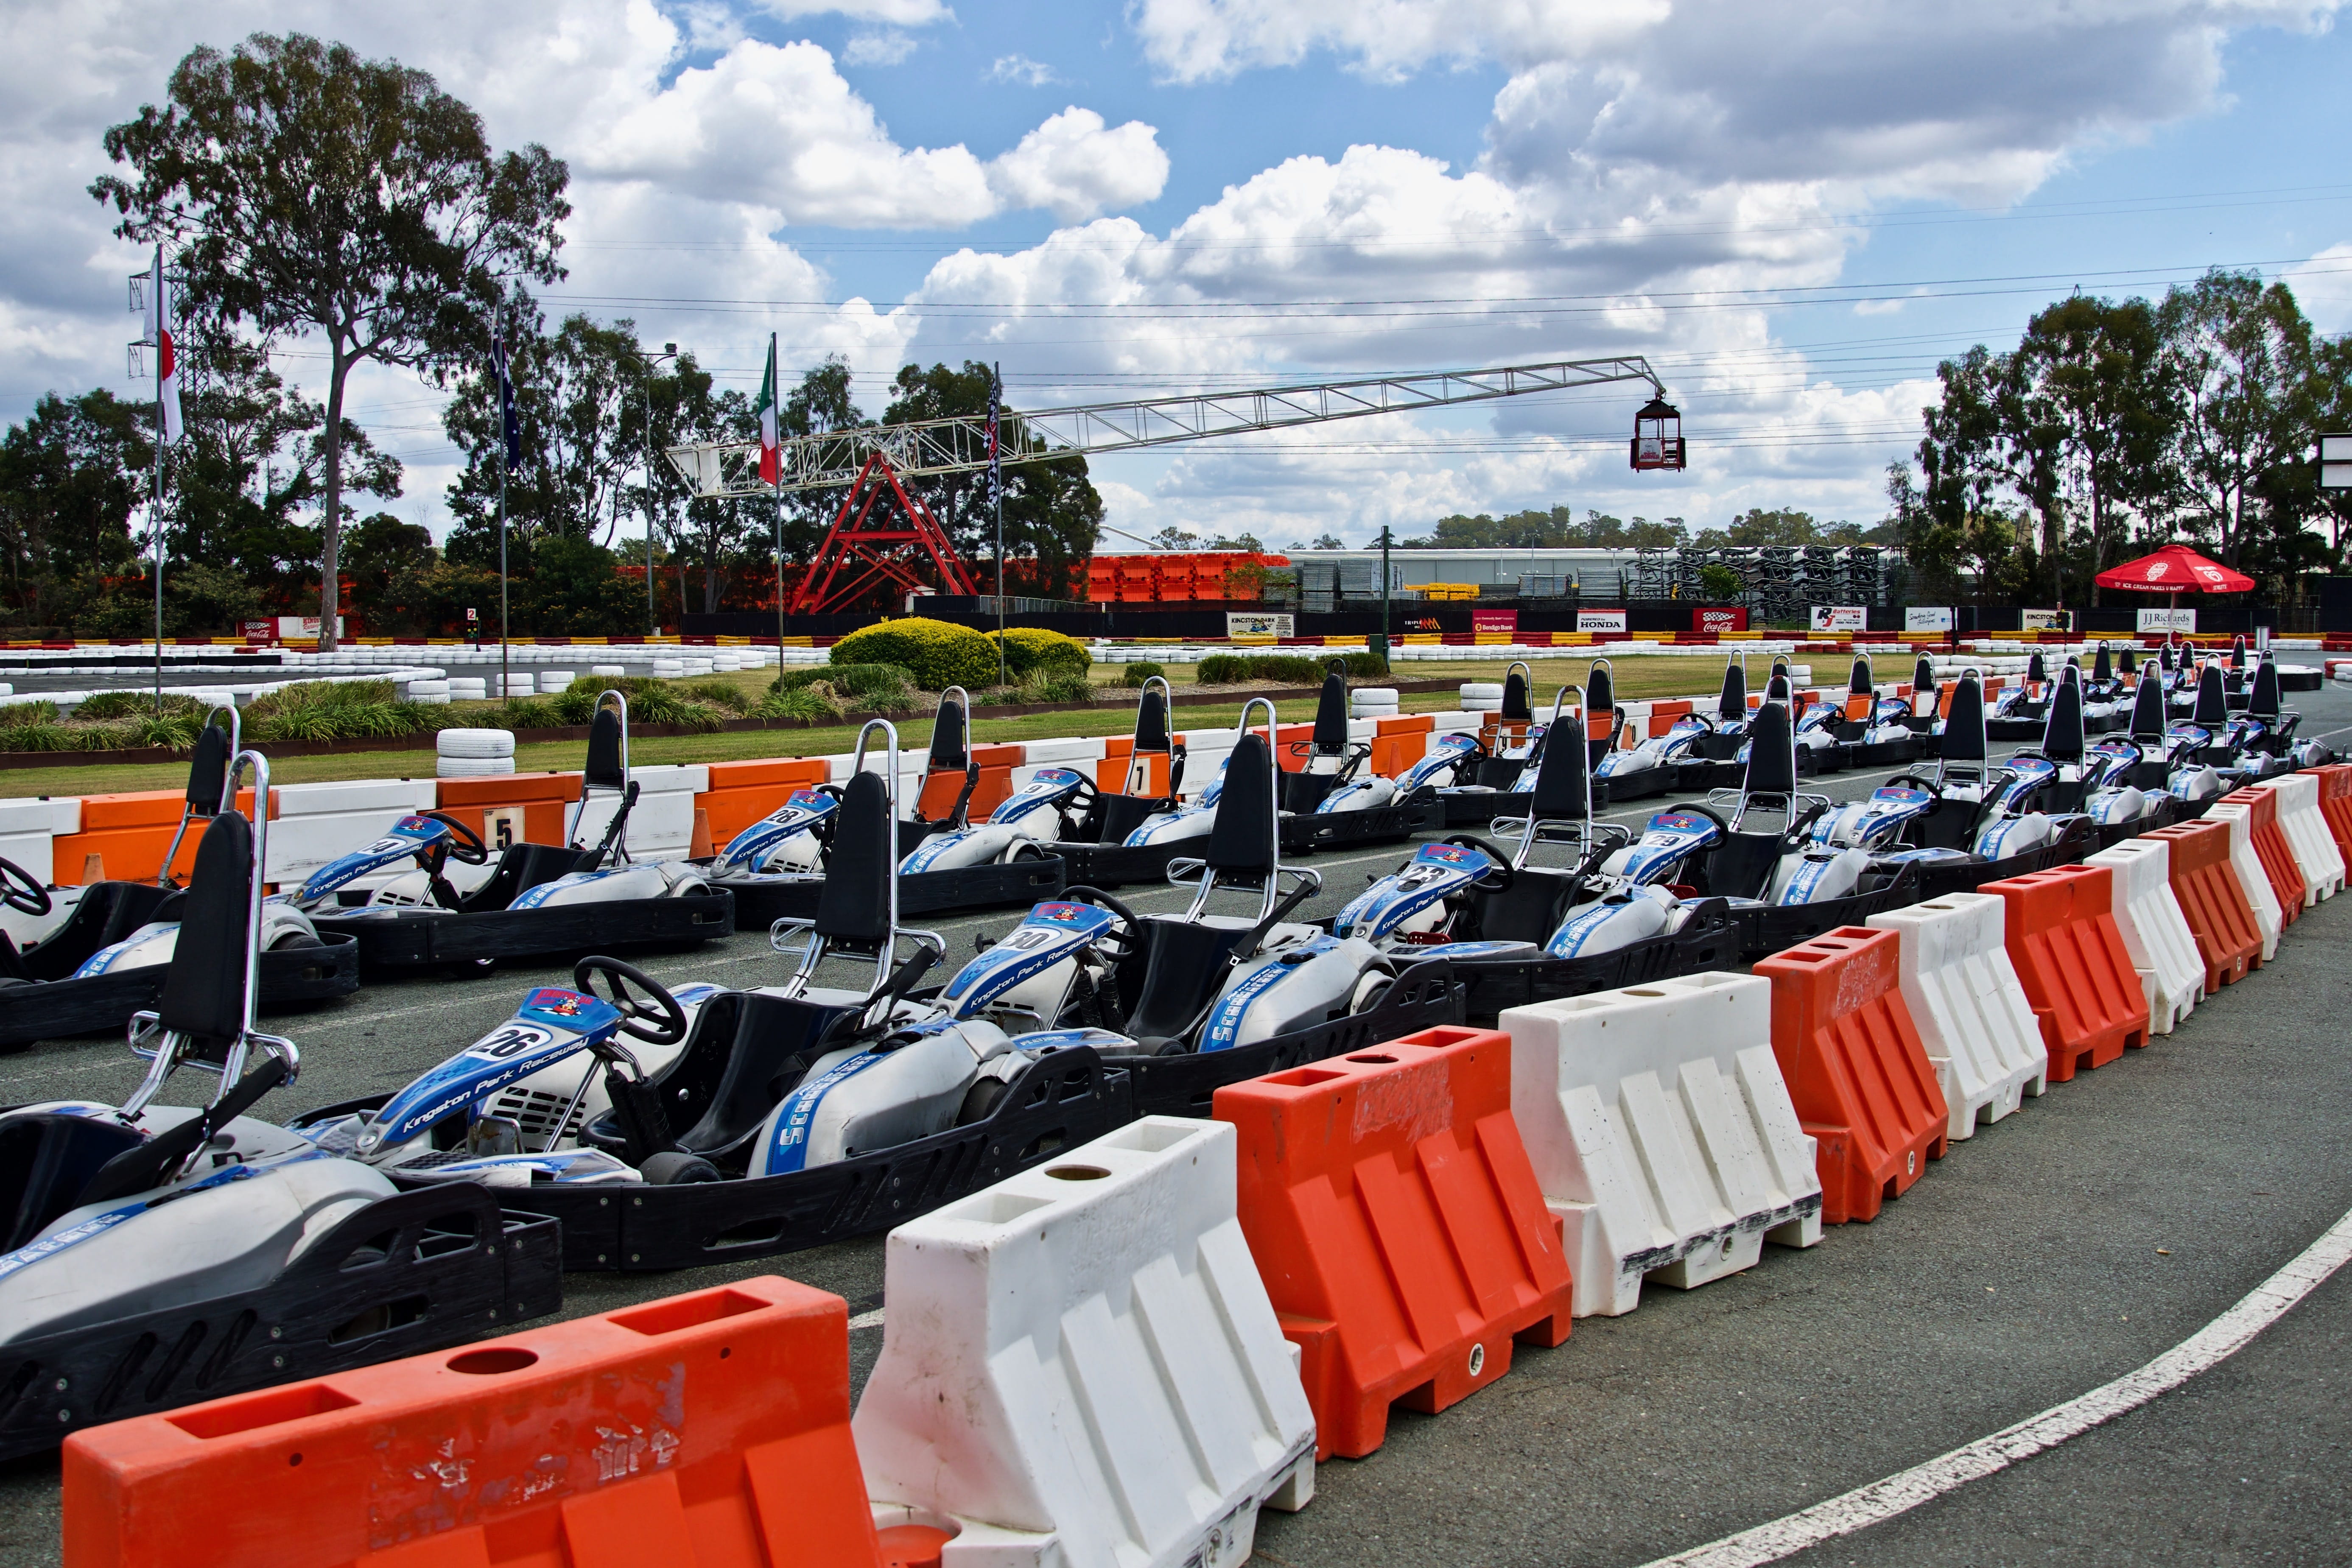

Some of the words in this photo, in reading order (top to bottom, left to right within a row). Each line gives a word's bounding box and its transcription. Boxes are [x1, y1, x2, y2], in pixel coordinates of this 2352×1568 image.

[468, 610, 475, 619] 2
[1817, 607, 1832, 619] R
[1822, 615, 1835, 627] J
[1431, 748, 1452, 757] 22
[1025, 785, 1043, 794] 9
[768, 809, 799, 823] 28
[1004, 808, 1026, 823] Kingston
[1027, 800, 1041, 811] Park
[1043, 788, 1068, 803] Raceway
[497, 819, 512, 851] 5
[738, 841, 768, 859] Kingston
[770, 830, 788, 843] Park
[790, 815, 823, 833] Raceway
[1866, 824, 1885, 837] Kingston
[1886, 818, 1897, 826] Park
[313, 871, 352, 894] Kingston
[354, 859, 378, 874] Park
[380, 843, 423, 863] Raceway
[1637, 866, 1659, 884] Kingston
[1659, 855, 1673, 868] Park
[1674, 839, 1701, 858] Raceway
[1401, 866, 1446, 884] 23
[1382, 906, 1415, 931] Kingston
[1415, 893, 1436, 909] Park
[1437, 874, 1474, 896] Raceway
[1000, 931, 1050, 950] 30
[970, 975, 1015, 1009] Kingston
[1016, 959, 1044, 979] Park
[1046, 932, 1093, 963] Raceway
[470, 1029, 540, 1058] 26
[402, 1090, 471, 1133] Kingston
[475, 1068, 515, 1095] Park
[518, 1036, 590, 1074] Raceway
